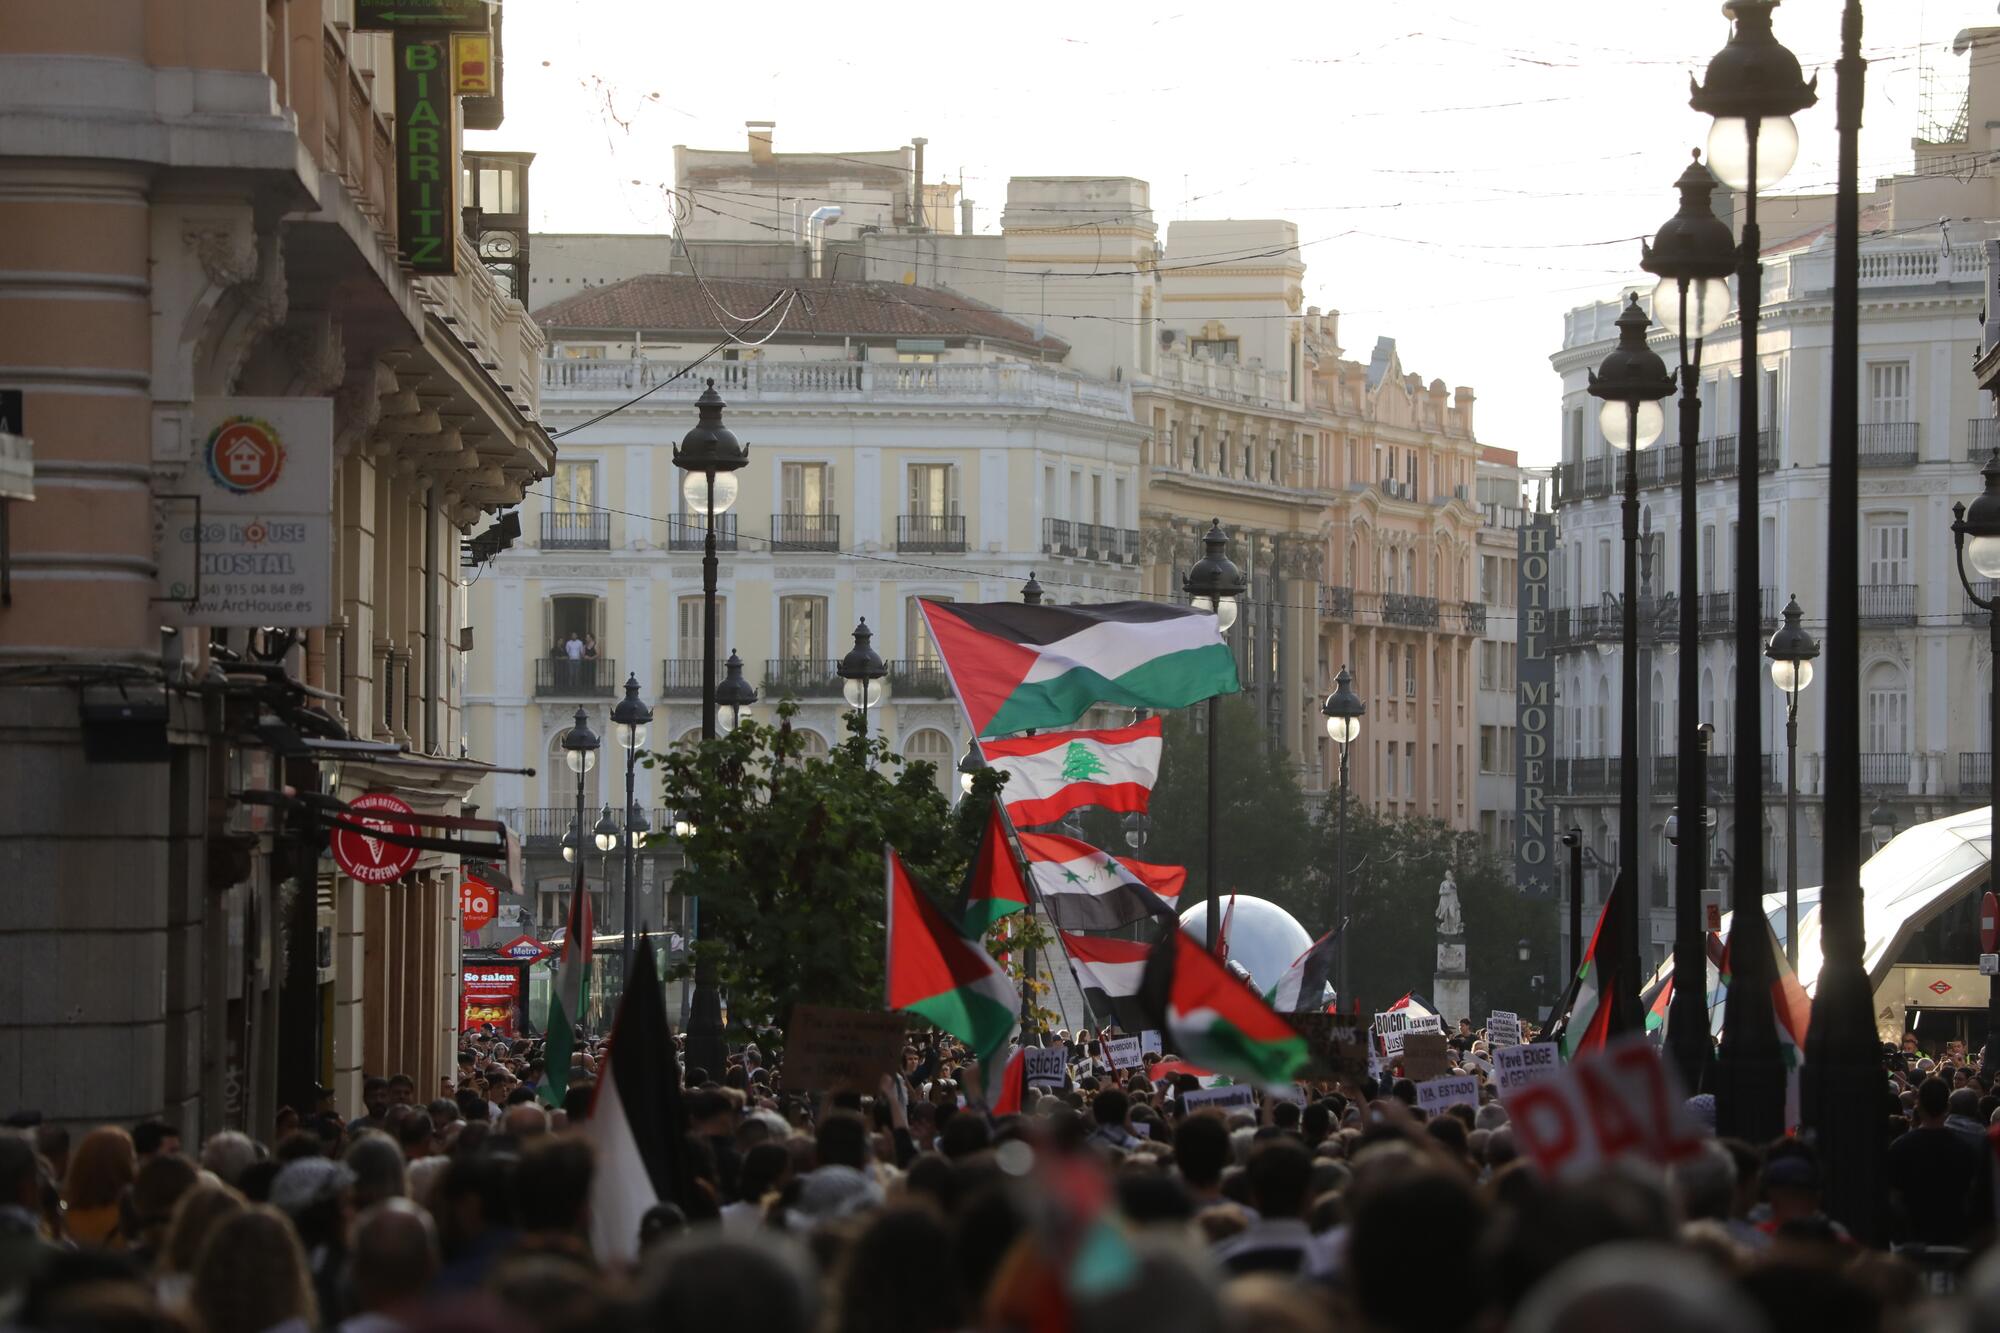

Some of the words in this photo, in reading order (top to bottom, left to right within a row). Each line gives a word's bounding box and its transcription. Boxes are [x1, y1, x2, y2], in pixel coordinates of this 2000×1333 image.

[406, 45, 442, 262] BIARRITZ
[190, 584, 220, 596] (34)
[225, 584, 247, 596] 915
[252, 584, 266, 596] 04
[1523, 528, 1548, 660] HOTEL
[1520, 681, 1548, 864] MODERNO
[352, 863, 367, 878] ICE
[368, 862, 400, 880] CREAM
[513, 947, 537, 956] Metro
[1523, 1047, 1552, 1066] EXIGE
[1438, 1081, 1474, 1097] ESTADO
